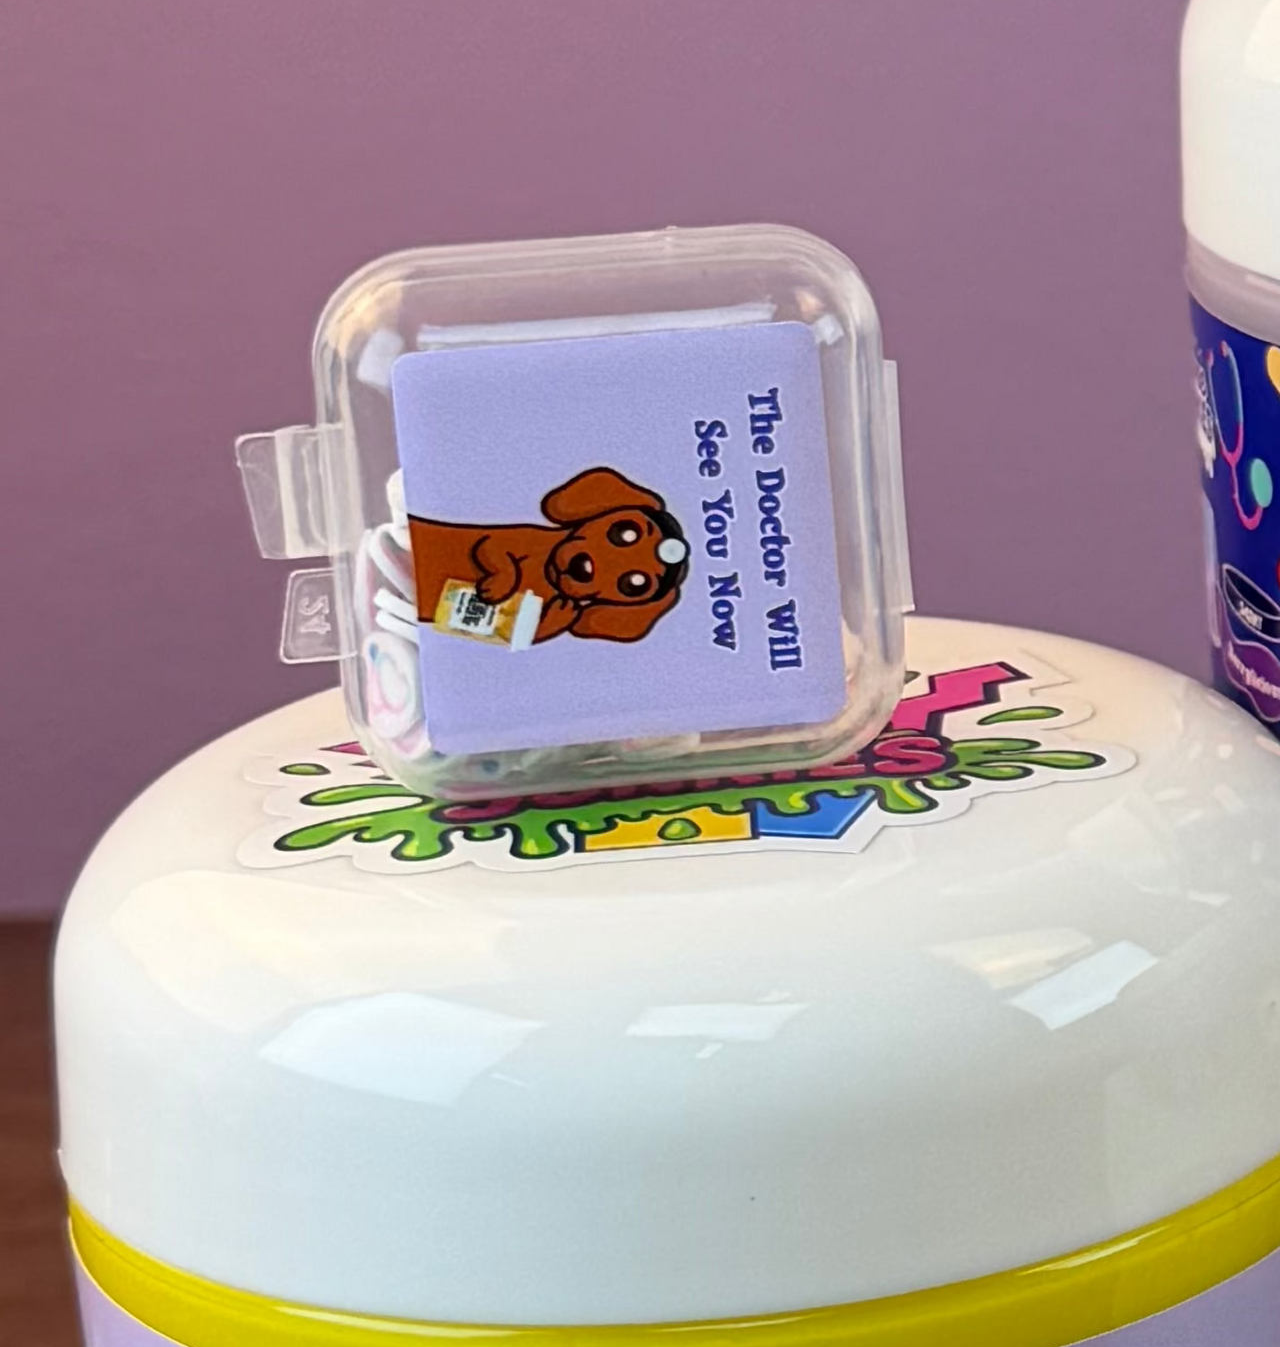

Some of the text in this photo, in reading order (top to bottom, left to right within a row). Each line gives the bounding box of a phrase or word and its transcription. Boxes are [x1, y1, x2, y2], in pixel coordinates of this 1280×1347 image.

[693, 419, 743, 652] See You Now
[747, 387, 804, 672] The Doctor Will
